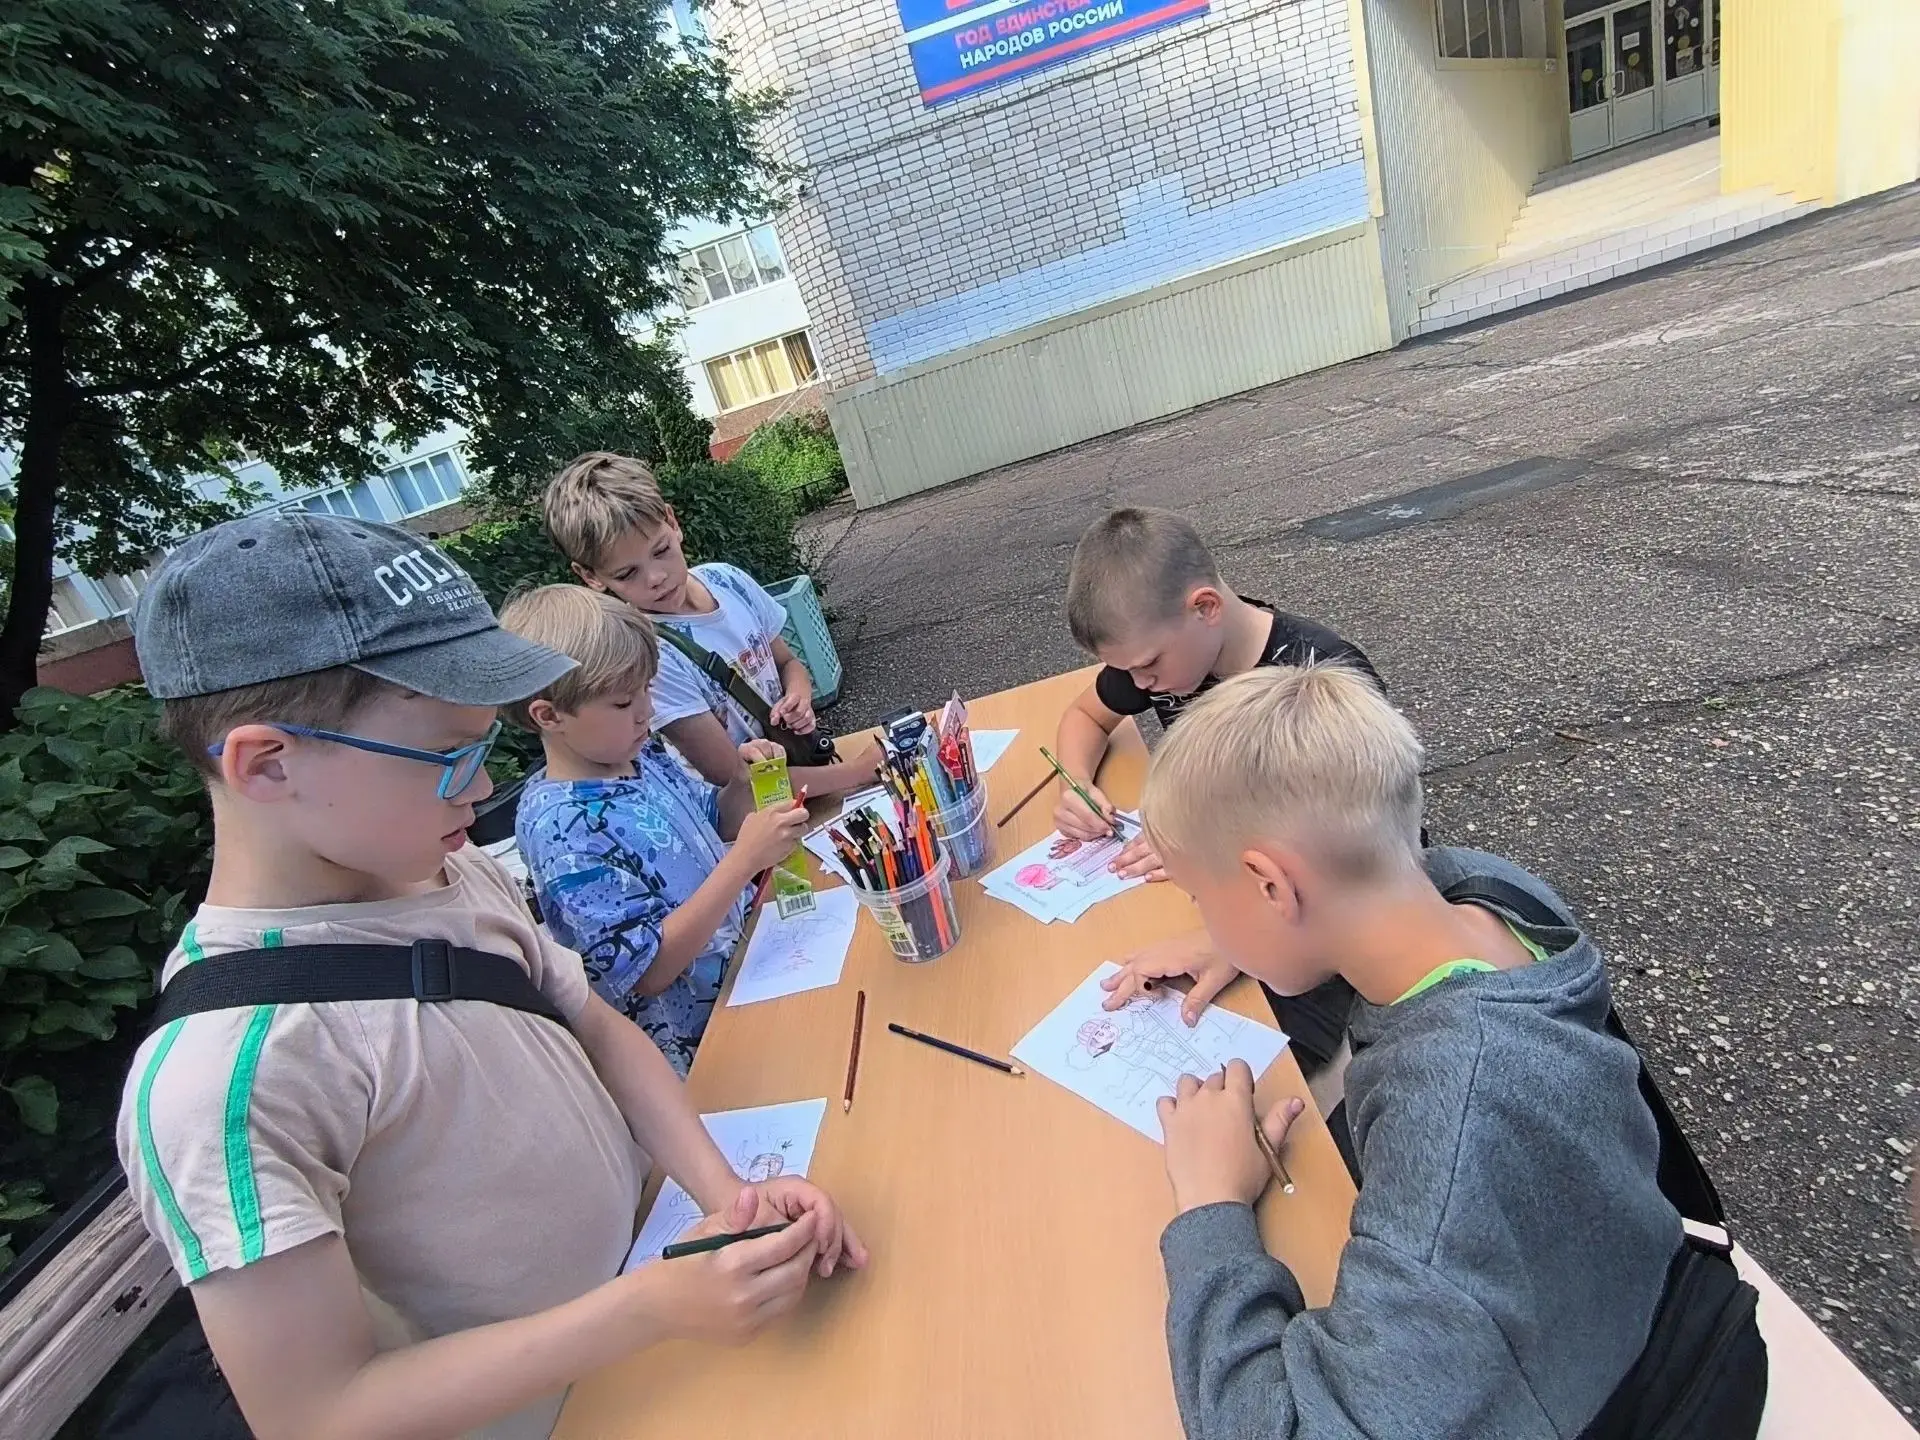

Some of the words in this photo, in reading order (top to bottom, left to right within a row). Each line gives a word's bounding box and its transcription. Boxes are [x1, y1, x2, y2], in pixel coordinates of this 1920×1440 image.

[954, 24, 992, 49] ГОД
[960, 27, 1045, 69] НАРОДОВ
[1048, 0, 1123, 39] РОССИИ
